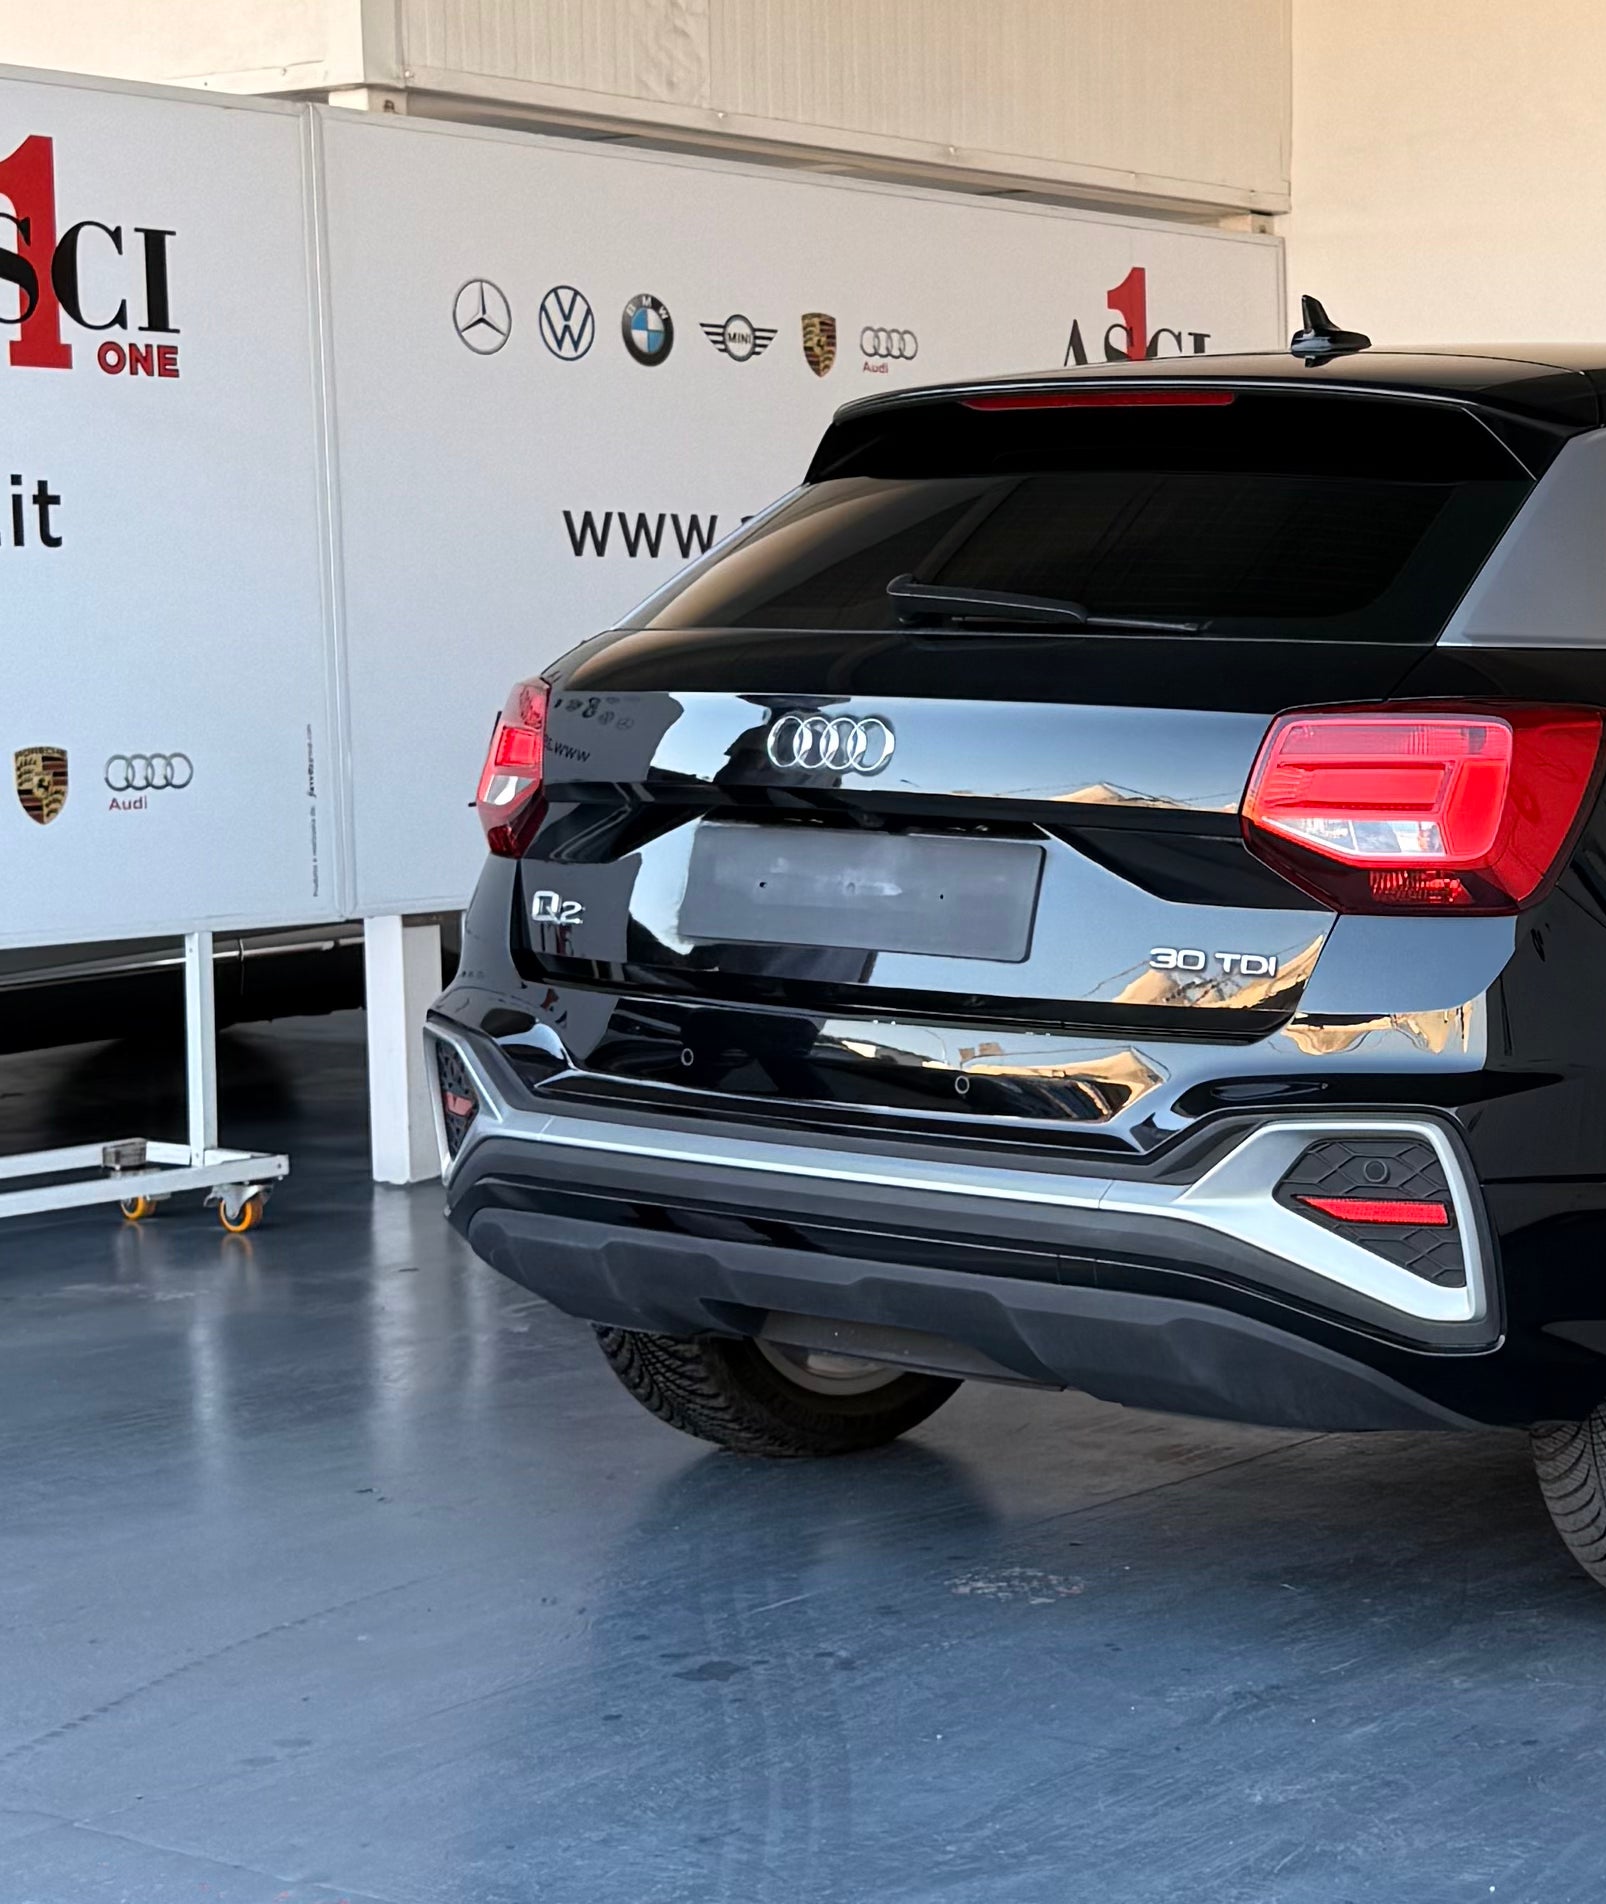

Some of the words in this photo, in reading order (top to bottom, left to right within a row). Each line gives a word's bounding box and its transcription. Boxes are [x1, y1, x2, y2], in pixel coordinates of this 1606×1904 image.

[728, 332, 752, 345] MINI
[97, 340, 180, 378] ONE
[862, 361, 889, 374] Audi
[0, 473, 63, 548] it
[108, 795, 149, 811] Audi
[532, 890, 584, 925] Q2
[1149, 947, 1206, 971] 30
[1215, 952, 1278, 977] TDI
